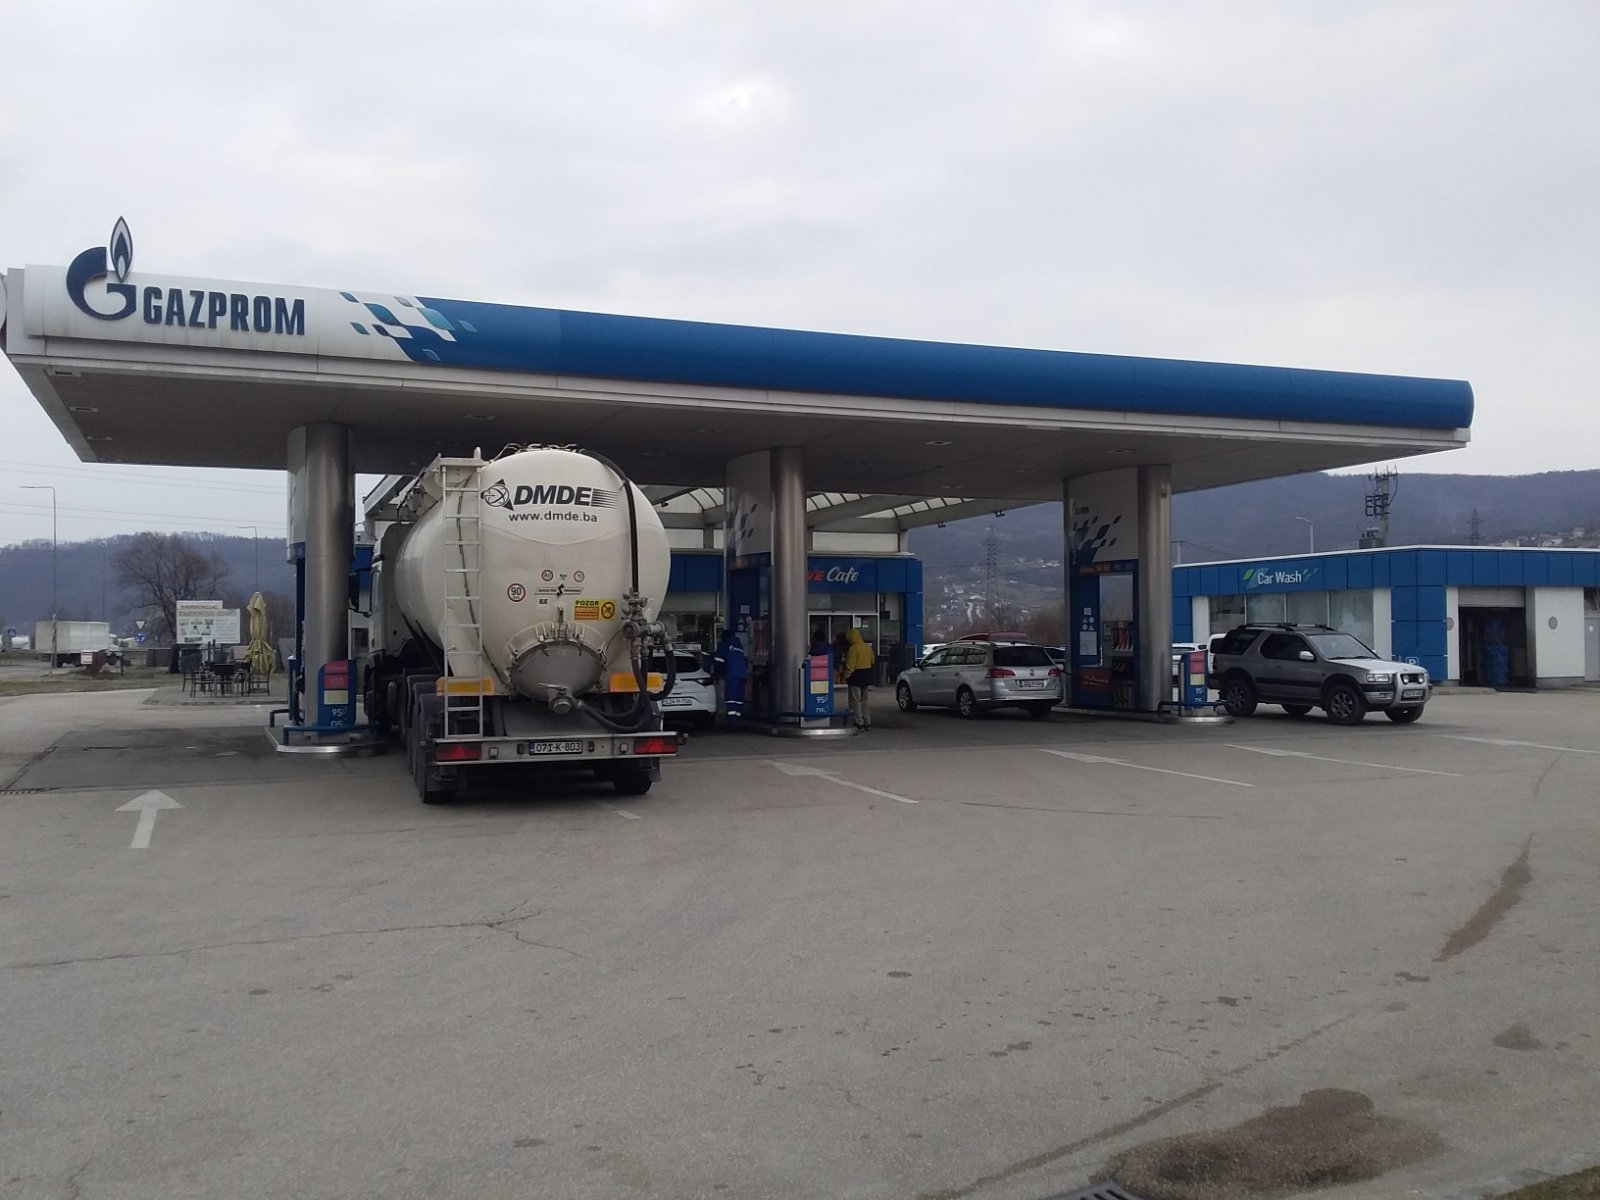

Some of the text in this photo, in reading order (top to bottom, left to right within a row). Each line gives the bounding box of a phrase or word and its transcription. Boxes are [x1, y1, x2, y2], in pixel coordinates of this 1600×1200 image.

[143, 286, 305, 336] GAZPROM
[513, 485, 592, 506] DMDE
[508, 510, 598, 522] www.dmde.ba
[1257, 570, 1302, 585] Car Wash
[510, 586, 522, 596] 90
[816, 696, 825, 704] 95
[331, 708, 343, 717] 95
